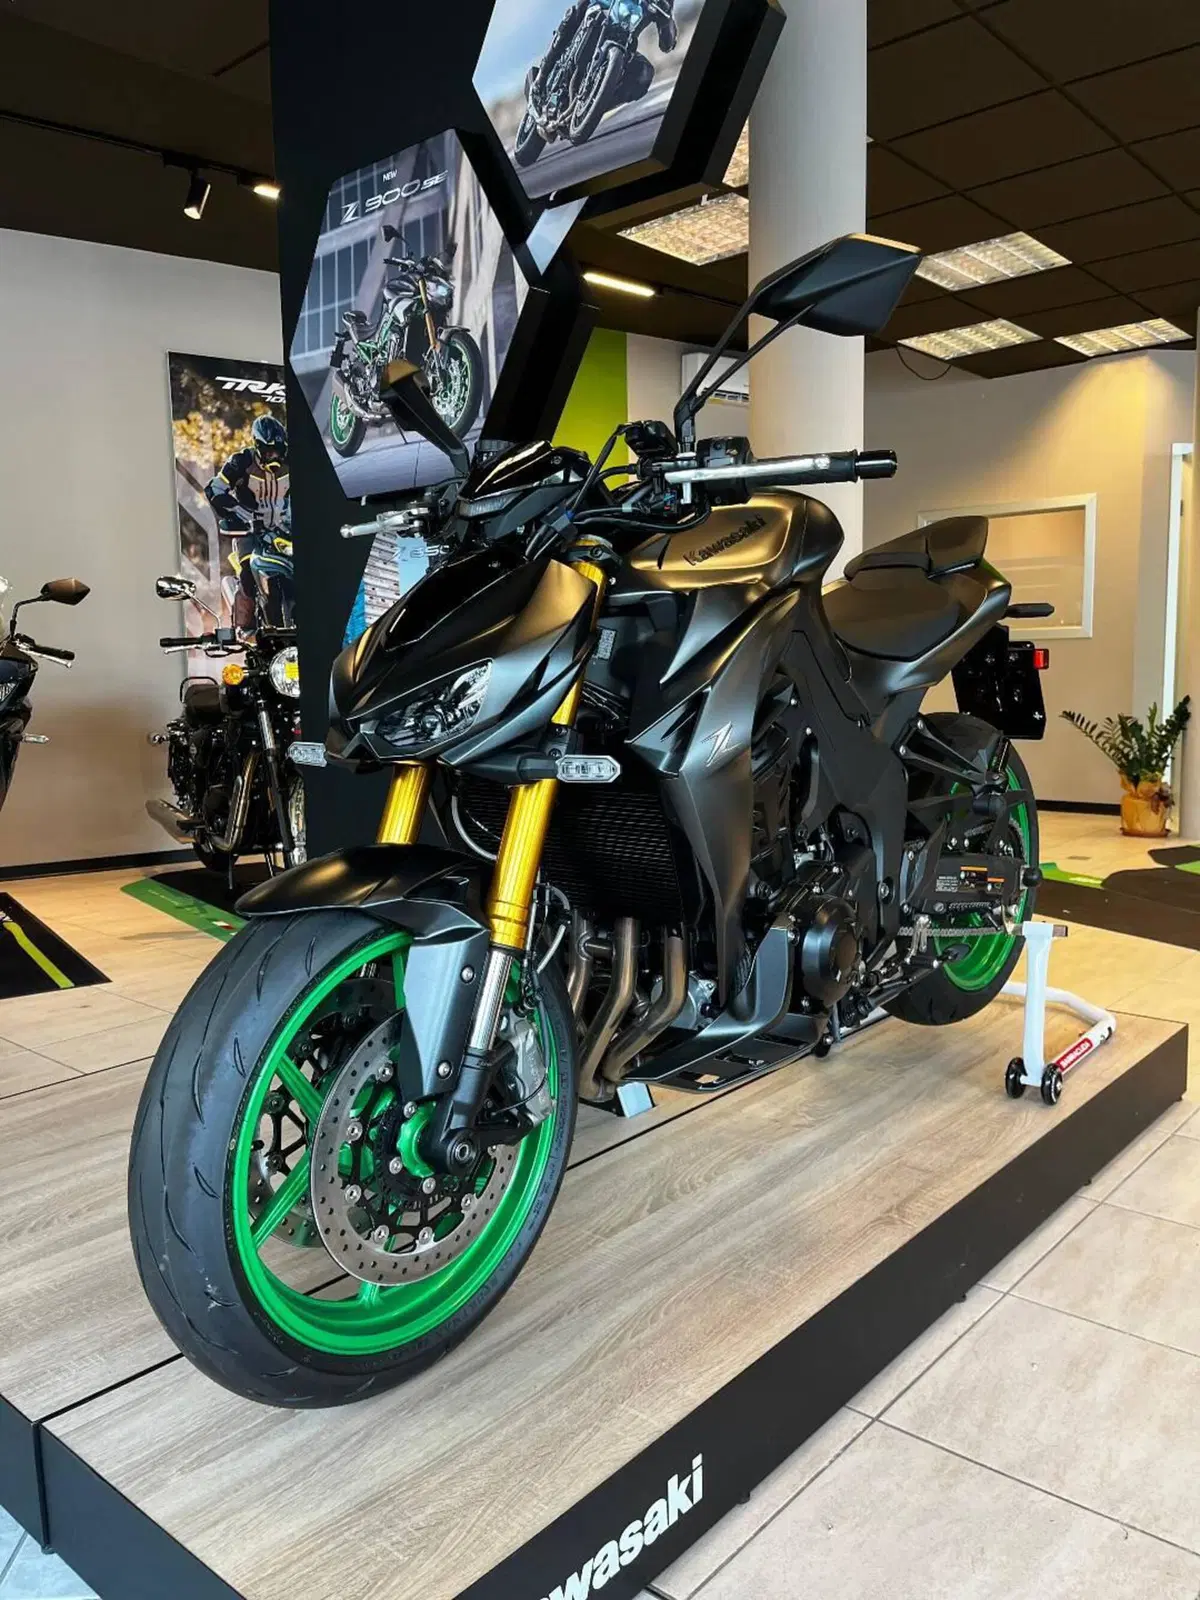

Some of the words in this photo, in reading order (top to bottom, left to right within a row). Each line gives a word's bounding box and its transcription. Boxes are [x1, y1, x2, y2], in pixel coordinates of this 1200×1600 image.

[383, 169, 398, 182] NEW
[214, 375, 286, 397] TRK
[261, 394, 287, 404] 70
[682, 513, 767, 567] Kawasaki
[540, 1453, 703, 1600] wasaki
